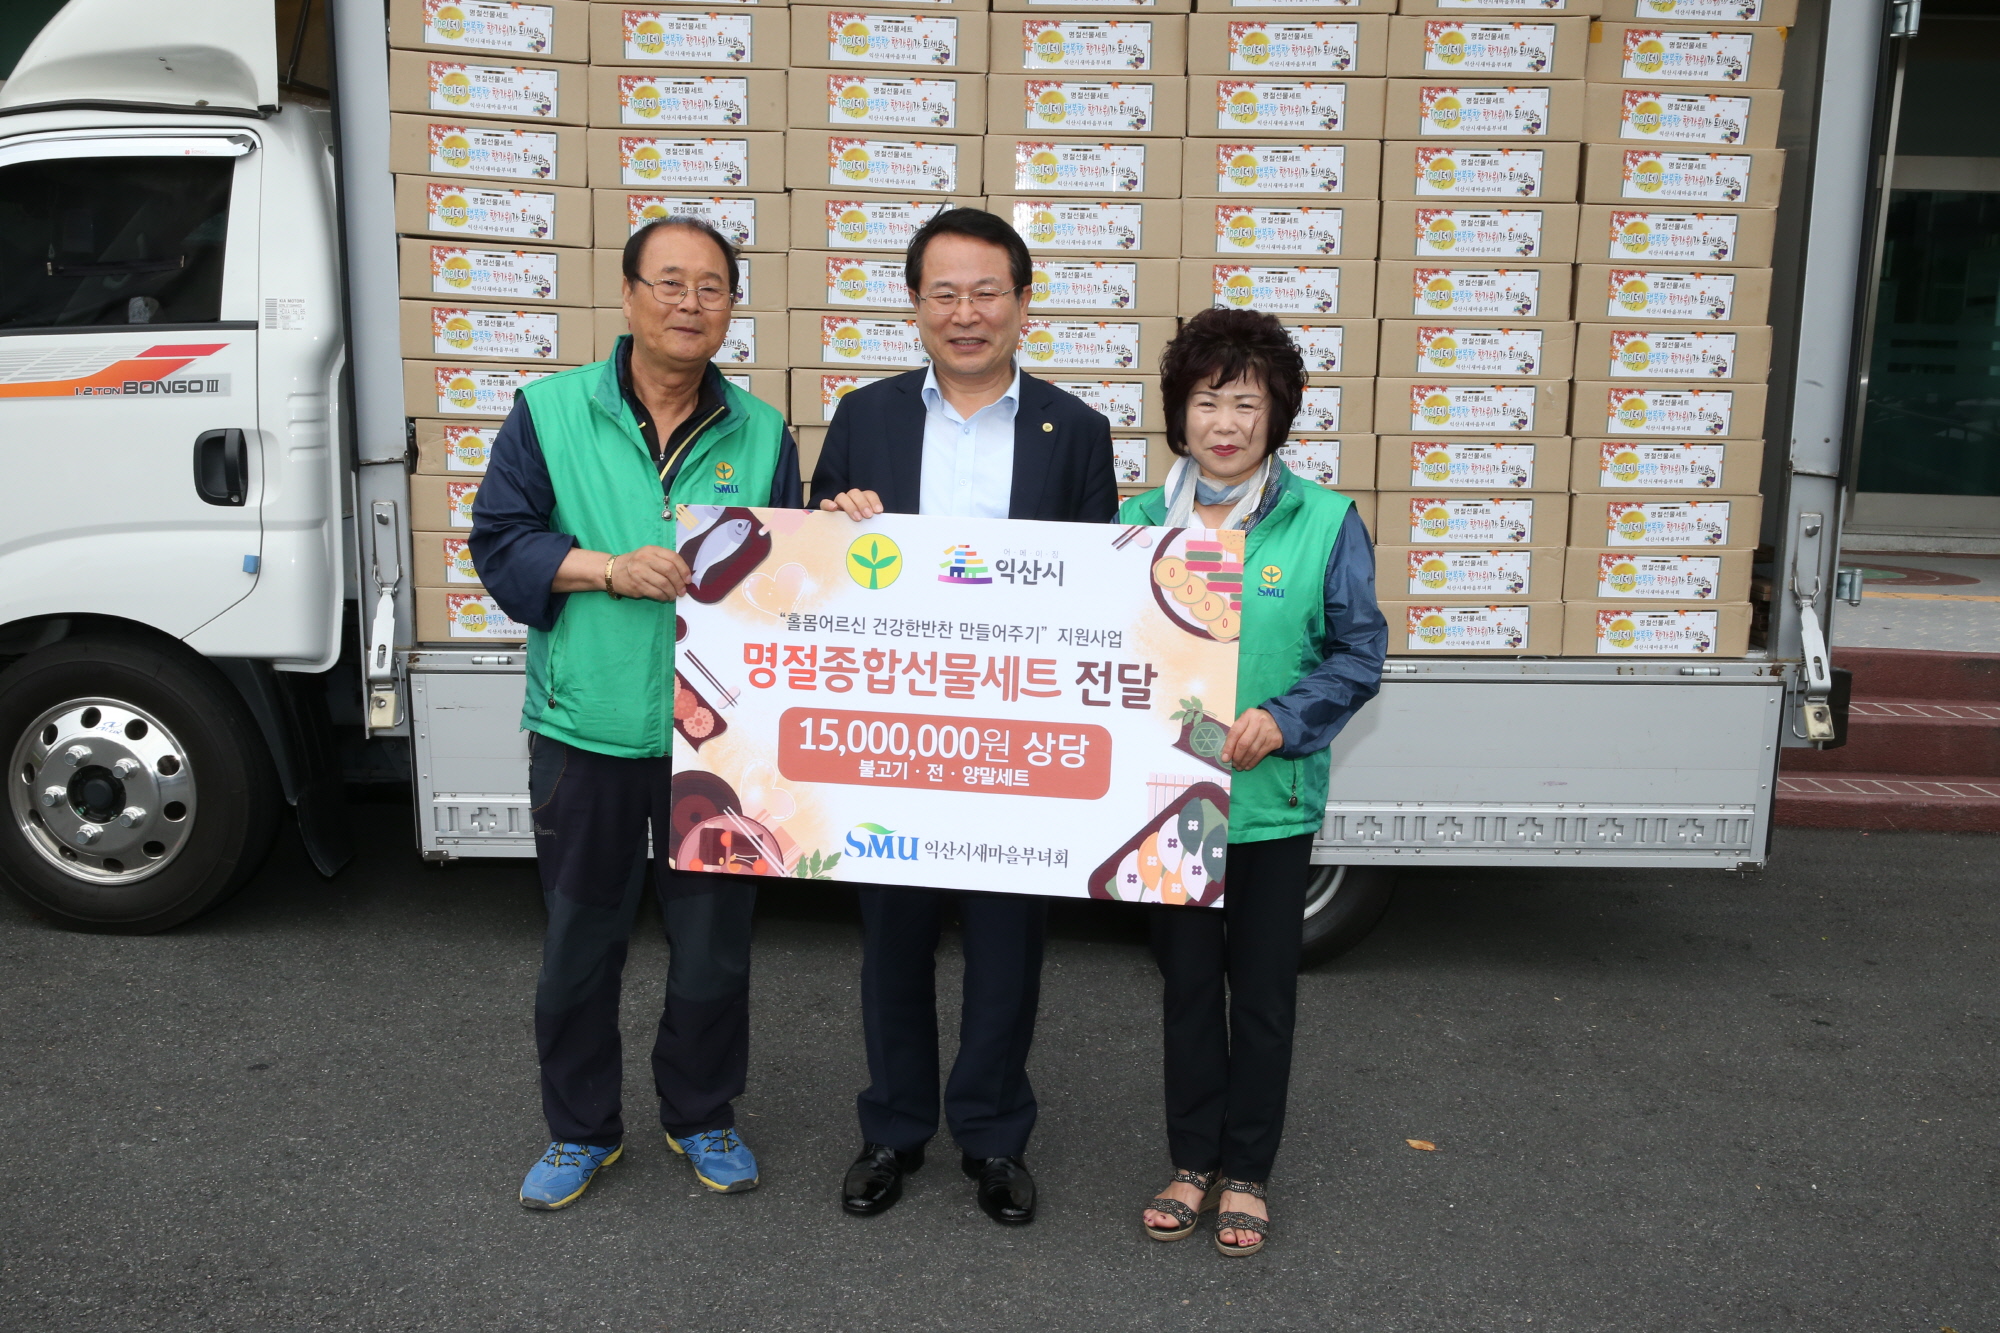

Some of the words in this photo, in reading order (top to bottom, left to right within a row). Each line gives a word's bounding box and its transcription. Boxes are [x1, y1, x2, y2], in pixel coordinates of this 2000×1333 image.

[668, 22, 707, 30] 명절선물세트
[873, 24, 913, 33] 명절선물세트
[662, 33, 683, 45] 행복한
[685, 34, 715, 46] 한가위가
[867, 35, 889, 48] 행복한
[890, 36, 920, 49] 한가위가
[1470, 32, 1510, 40] 명절선물세트
[1062, 42, 1083, 53] 행복한
[1085, 42, 1115, 54] 한가위가
[1267, 43, 1289, 55] 행복한
[1290, 43, 1320, 55] 한가위가
[1463, 44, 1485, 56] 행복한
[1486, 44, 1517, 56] 한가위가
[1668, 41, 1708, 49] 명절선물세트
[868, 52, 916, 60] 익산시새마을부녀회
[1660, 52, 1683, 64] 행복한
[1683, 53, 1714, 65] 한가위가
[474, 74, 513, 83] 명절선물세트
[468, 85, 489, 97] 행복한
[491, 86, 521, 99] 한가위가
[873, 87, 912, 95] 명절선물세트
[469, 101, 517, 110] 익산시새마을부녀회
[658, 97, 680, 108] 행복한
[681, 97, 711, 109] 한가위가
[866, 98, 888, 110] 행복한
[889, 99, 919, 111] 한가위가
[1064, 103, 1085, 114] 행복한
[1087, 103, 1116, 115] 한가위가
[1255, 103, 1277, 115] 행복한
[1278, 104, 1308, 115] 한가위가
[868, 114, 915, 122] 익산시새마을부녀회
[1458, 108, 1480, 119] 행복한
[1482, 108, 1512, 119] 한가위가
[474, 137, 513, 146] 명절선물세트
[467, 147, 489, 160] 행복한
[491, 149, 520, 162] 한가위가
[664, 147, 703, 155] 명절선물세트
[873, 149, 912, 158] 명절선물세트
[469, 163, 516, 172] 익산시새마을부녀회
[659, 158, 680, 170] 행복한
[682, 159, 711, 170] 한가위가
[867, 160, 888, 172] 행복한
[890, 161, 920, 174] 한가위가
[1668, 162, 1707, 170] 명절선물세트
[1255, 166, 1277, 177] 행복한
[1278, 166, 1308, 177] 한가위가
[868, 176, 915, 184] 익산시새마을부녀회
[1660, 173, 1682, 185] 행복한
[1683, 173, 1713, 185] 한가위가
[475, 258, 513, 267] 명절선물세트
[469, 269, 490, 281] 행복한
[492, 270, 521, 283] 한가위가
[471, 285, 517, 293] 익산시새마을부녀회
[1454, 348, 1476, 358] 행복한
[1477, 348, 1506, 359] 한가위가
[75, 387, 93, 396] 1.2
[95, 387, 122, 396] TON
[122, 380, 204, 395] BONGO
[1448, 462, 1469, 473] 행복한
[1470, 462, 1499, 473] 한가위가
[1636, 463, 1658, 473] 행복한
[1659, 463, 1688, 474] 한가위가
[713, 484, 740, 494] SMU
[995, 558, 1065, 587] 익산시
[1257, 586, 1286, 599] SMU
[872, 616, 954, 639] 건강한반찬
[959, 622, 1048, 645] 만들어주기”
[1057, 627, 1123, 649] 지원사업
[743, 642, 1063, 703] 명절종합선물세트
[1075, 658, 1159, 711] 전달
[799, 717, 1011, 764] 15,000,000원
[1022, 731, 1091, 769] 상당
[858, 759, 910, 781] 불고기
[926, 763, 945, 783] 전
[962, 766, 1030, 788] 양말세트
[844, 829, 920, 861] SMU
[924, 839, 1069, 869] 익산시새마을부녀회
